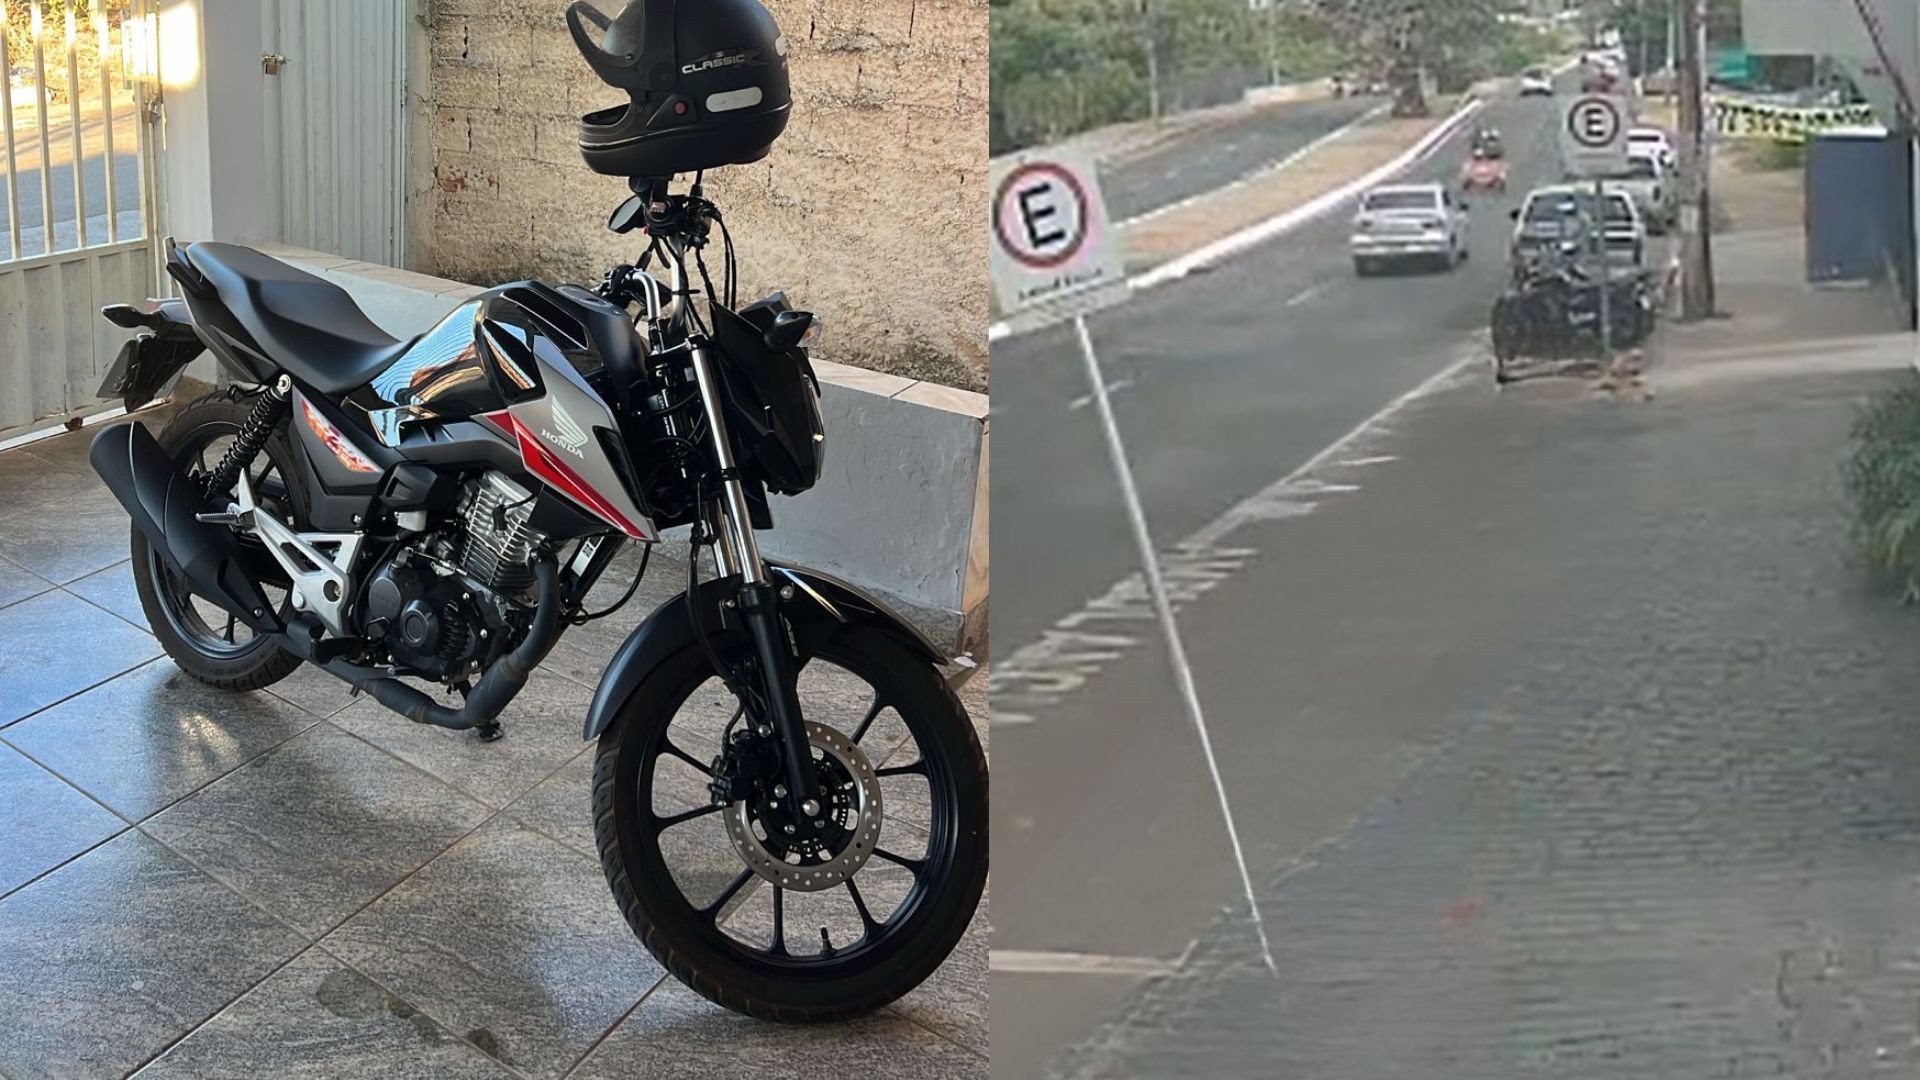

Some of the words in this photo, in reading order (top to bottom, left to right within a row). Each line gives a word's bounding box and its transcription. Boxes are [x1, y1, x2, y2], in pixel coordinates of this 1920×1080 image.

[682, 54, 745, 75] CLASSIC
[1585, 108, 1604, 137] E
[1018, 181, 1066, 249] E
[541, 428, 585, 460] HONDA
